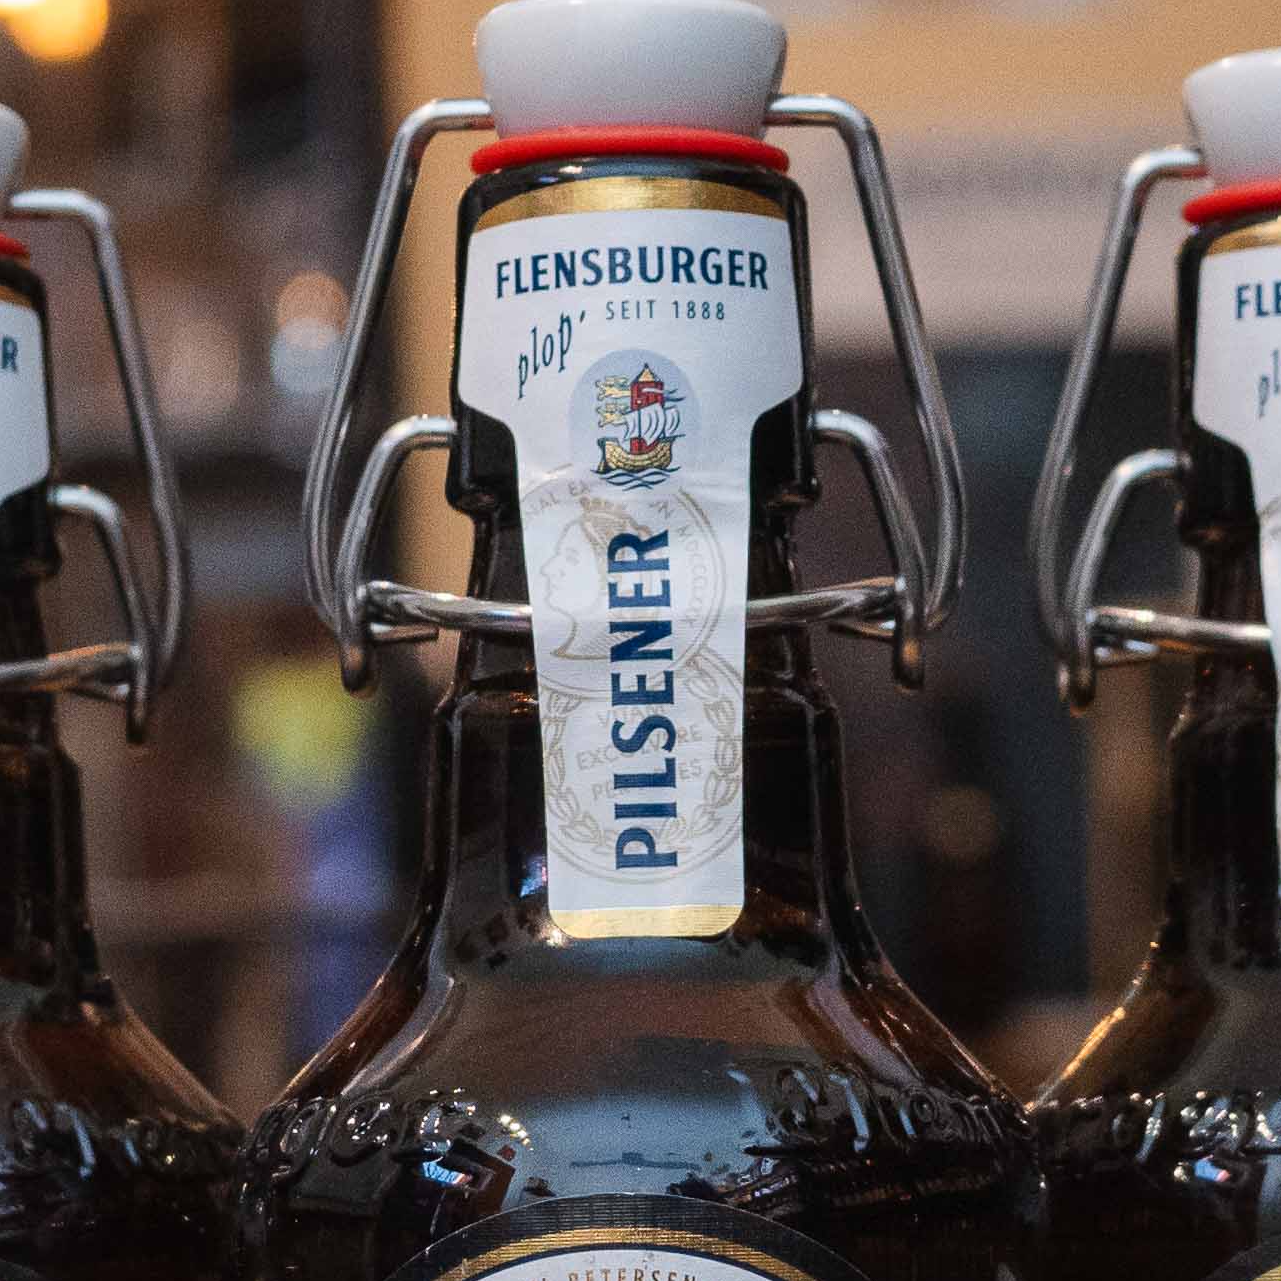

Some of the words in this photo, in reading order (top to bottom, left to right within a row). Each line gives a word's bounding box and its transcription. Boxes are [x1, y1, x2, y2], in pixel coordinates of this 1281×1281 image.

[495, 245, 769, 299] FLENSBURGER
[605, 299, 656, 320] SEIT
[671, 300, 726, 321] 1888
[606, 528, 679, 871] PILSENER
